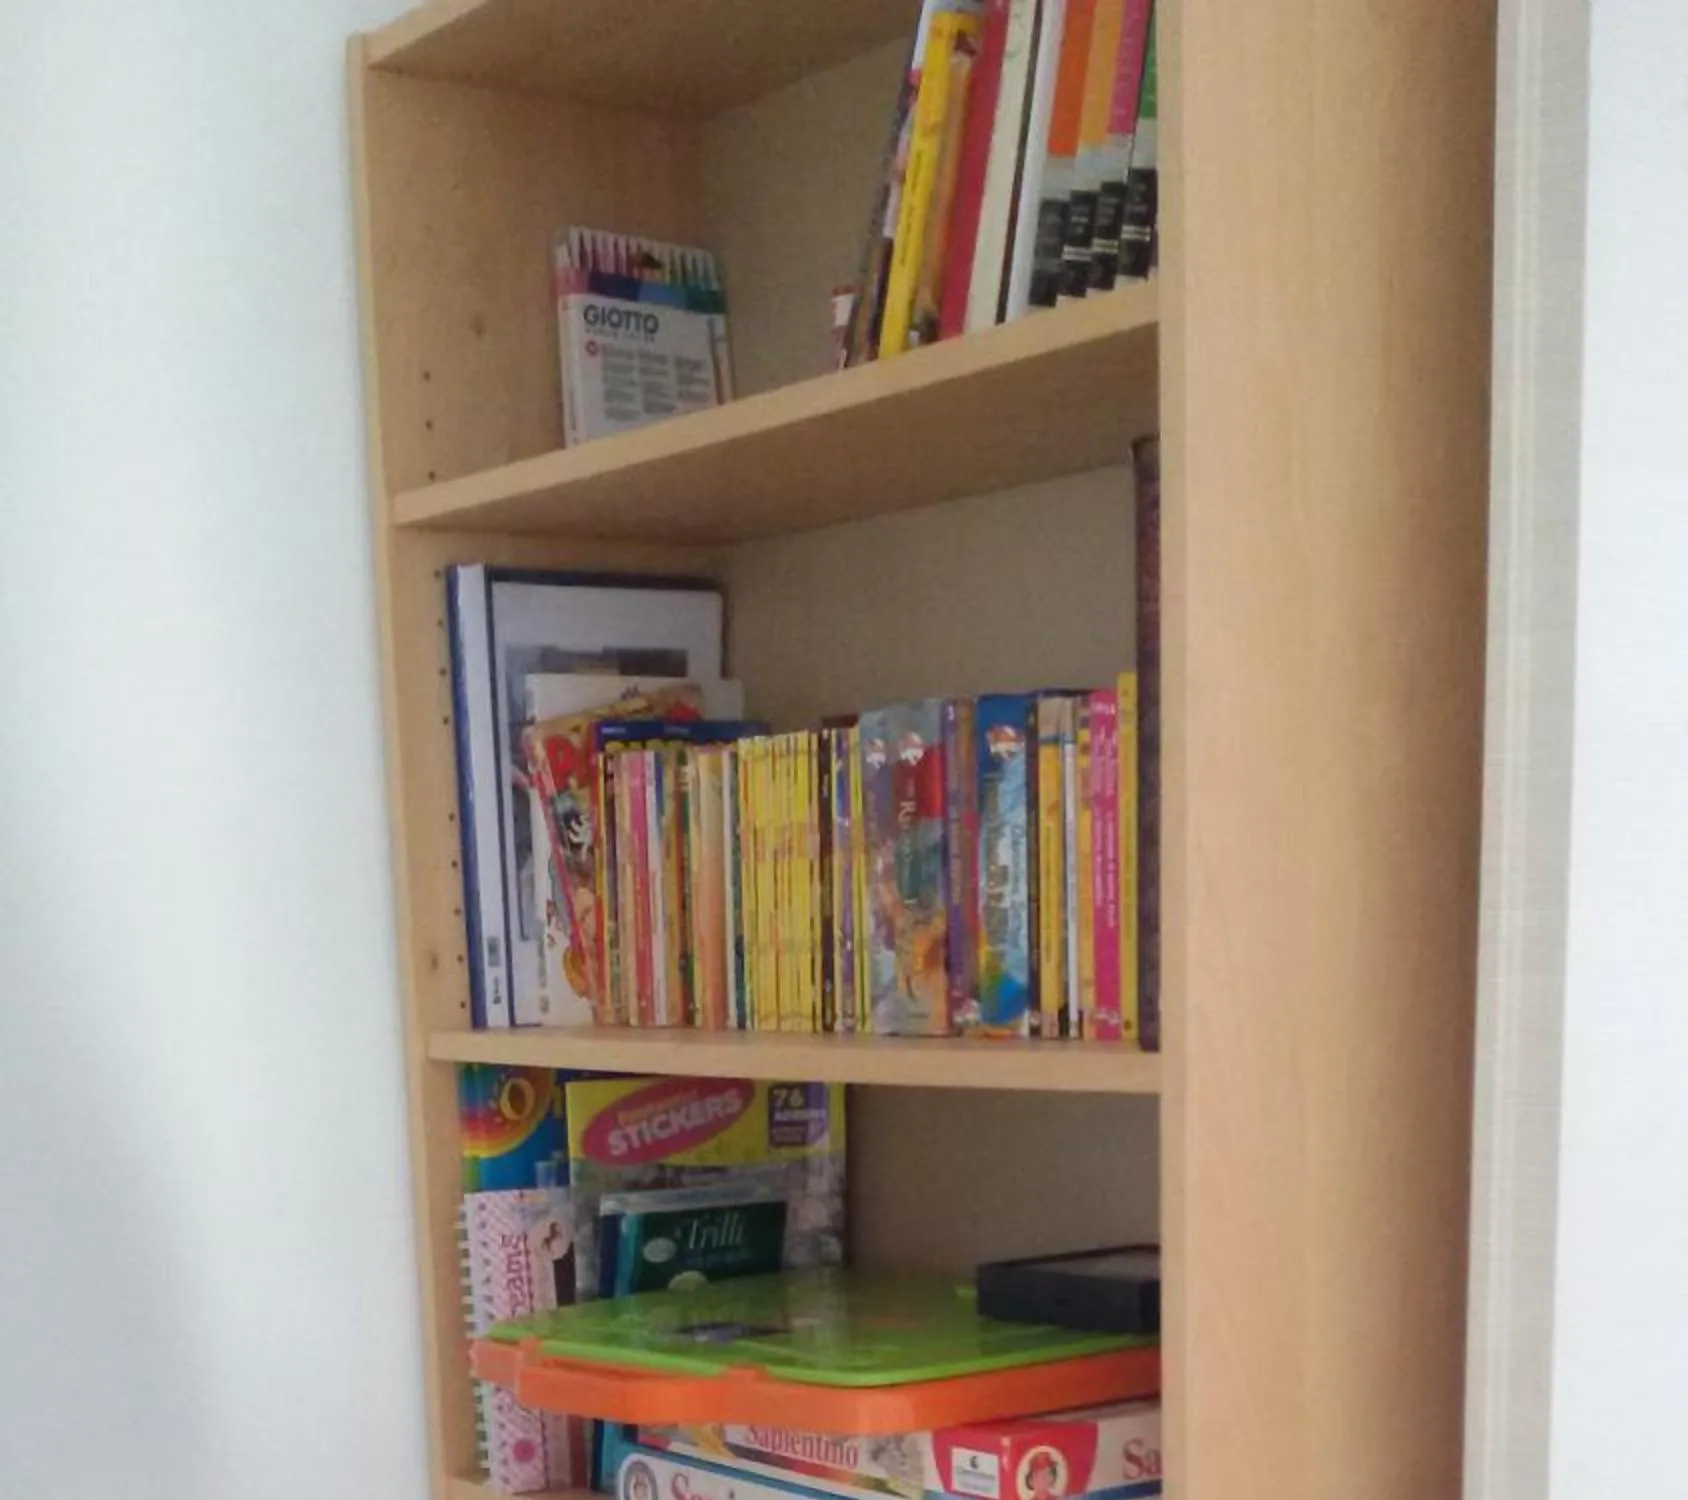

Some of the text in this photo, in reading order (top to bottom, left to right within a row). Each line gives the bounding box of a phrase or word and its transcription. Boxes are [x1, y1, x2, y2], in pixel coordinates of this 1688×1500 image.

[583, 304, 660, 335] GIOTTO
[607, 1088, 745, 1157] STICKERS
[1121, 1436, 1161, 1480] Sa
